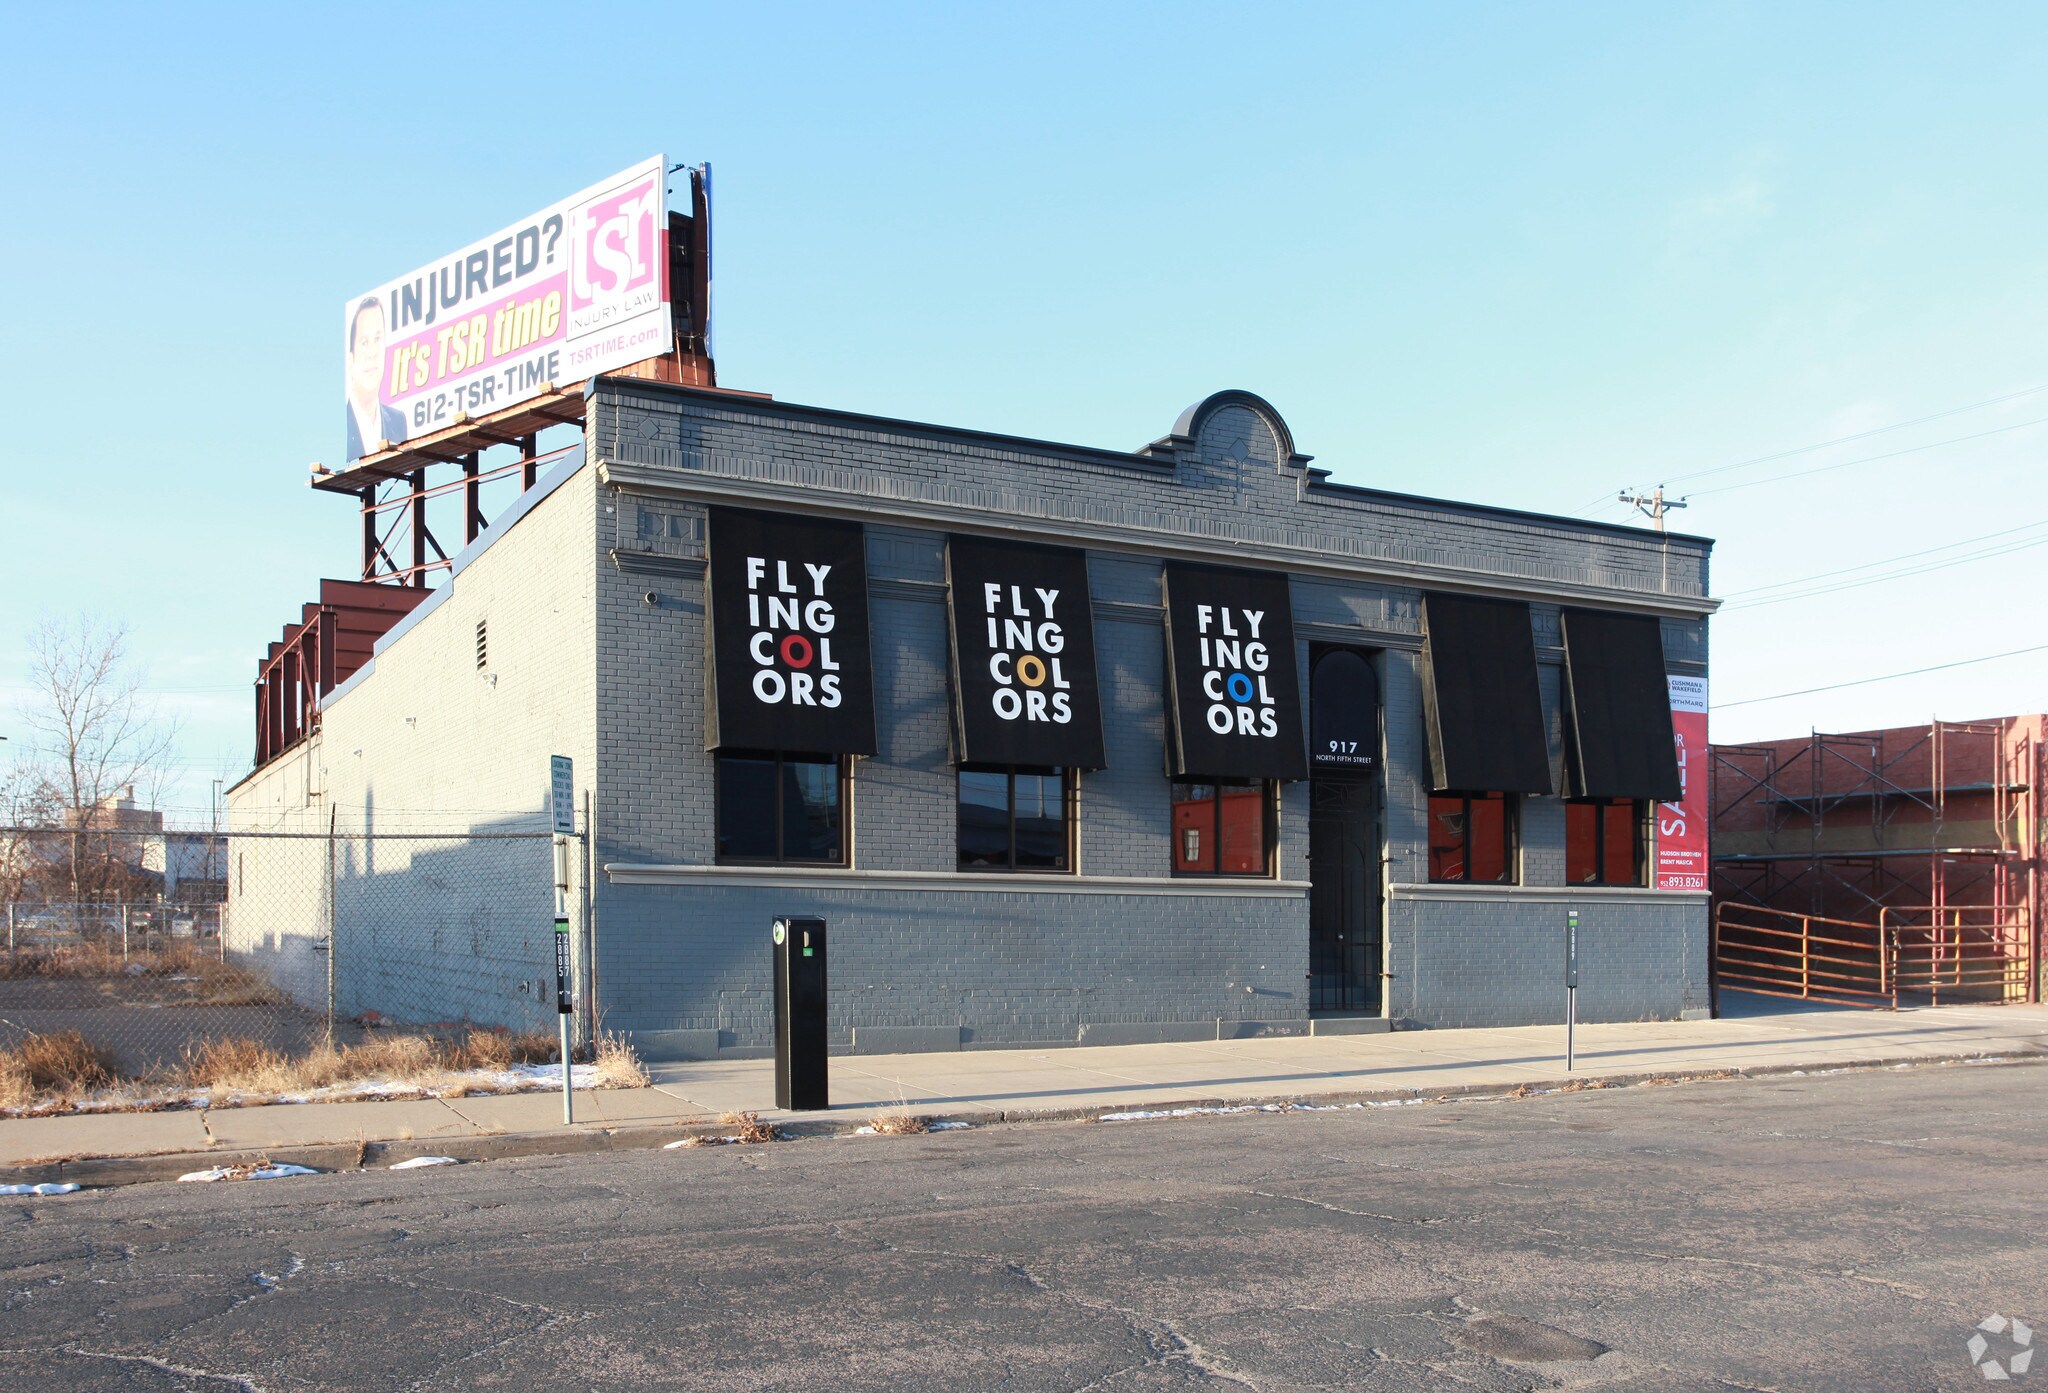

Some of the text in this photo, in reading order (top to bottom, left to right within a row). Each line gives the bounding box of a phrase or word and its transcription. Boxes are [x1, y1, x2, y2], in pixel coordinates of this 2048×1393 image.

[391, 213, 563, 332] INJURED?
[570, 291, 654, 332] INJURY LAW
[390, 290, 562, 397] It's TSR time
[569, 328, 658, 366] TSRTIME.com
[414, 350, 560, 428] 612-TSR-TIME
[747, 557, 832, 596] FLY
[749, 594, 835, 634] ING
[984, 582, 1060, 619] FLY
[987, 617, 1064, 654] ING
[1197, 604, 1264, 639] FLY
[750, 631, 840, 670] COL
[1200, 637, 1269, 672] ING
[752, 669, 842, 708] ORS
[990, 652, 1070, 689] COL
[1203, 670, 1275, 704] COL
[1671, 680, 1698, 688] CUSHMAN
[992, 687, 1072, 724] ORS
[1207, 703, 1278, 738] ORS
[1316, 754, 1336, 762] NORTH
[1329, 740, 1358, 754] 917
[1669, 877, 1704, 887] 893.8261
[556, 933, 564, 977] 2885
